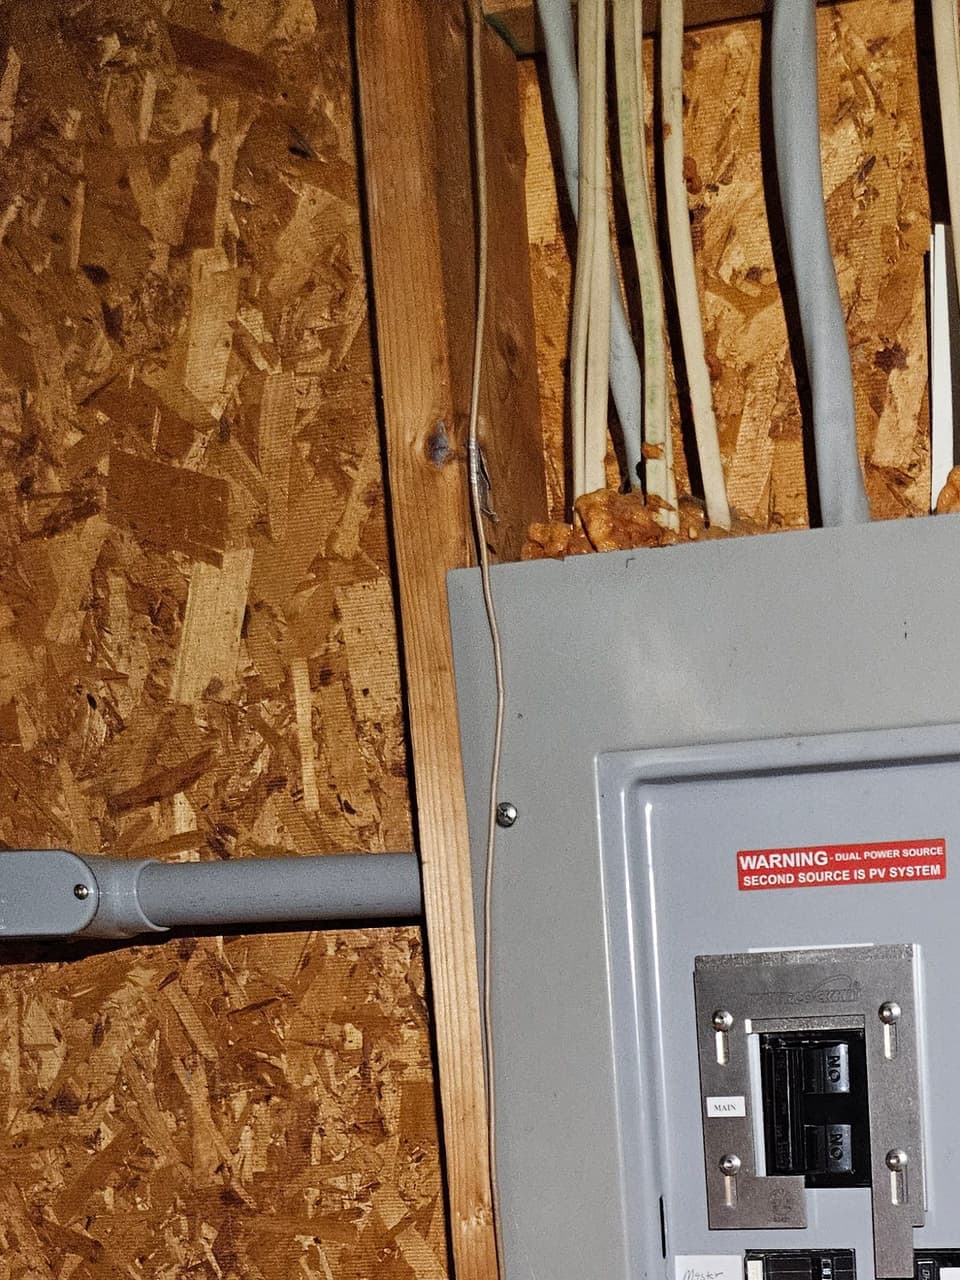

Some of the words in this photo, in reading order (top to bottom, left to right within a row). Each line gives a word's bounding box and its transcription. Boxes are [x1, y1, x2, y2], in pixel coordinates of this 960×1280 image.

[739, 851, 828, 870] WARNING
[835, 853, 862, 862] DUAL
[863, 850, 901, 860] POWER
[902, 846, 944, 857] SOURCE
[743, 873, 795, 887] SECOND
[798, 869, 850, 884] SOURCE
[853, 868, 866, 880] IS
[869, 866, 886, 879] PV
[889, 864, 941, 878] SYSTEM
[712, 1102, 738, 1112] MAIN
